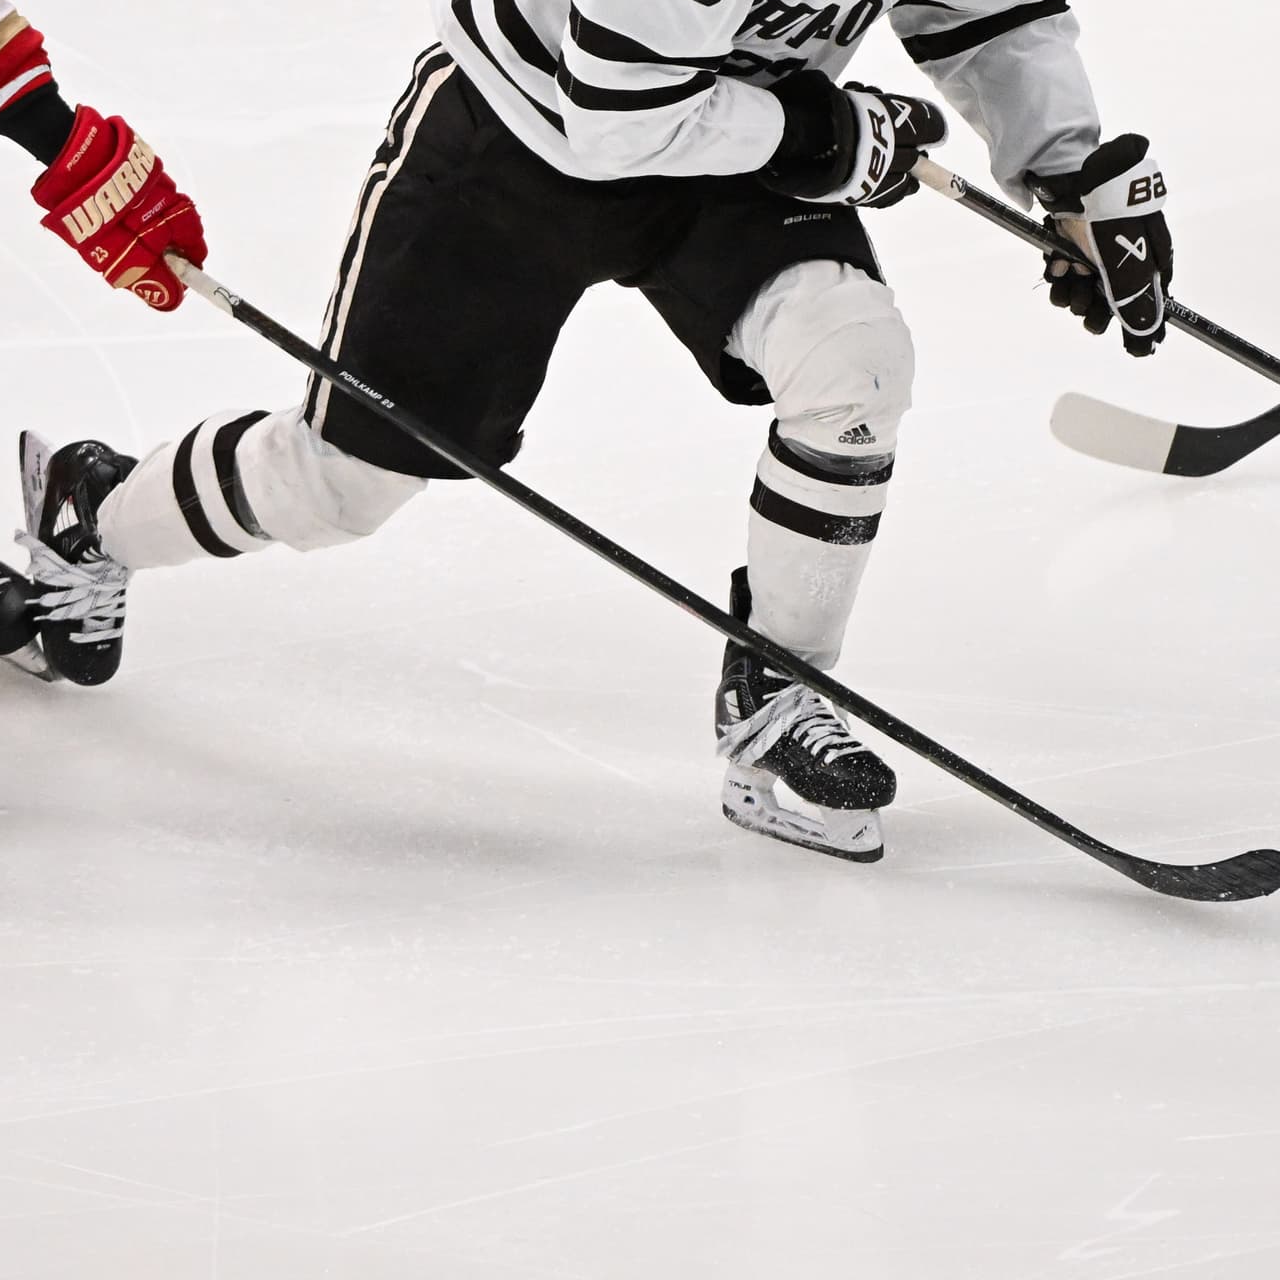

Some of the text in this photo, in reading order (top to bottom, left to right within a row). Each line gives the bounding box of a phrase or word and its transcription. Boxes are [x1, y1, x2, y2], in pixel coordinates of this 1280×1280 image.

[90, 245, 109, 264] 23
[339, 370, 396, 410] POHLKAMP 23
[838, 435, 877, 446] adidas
